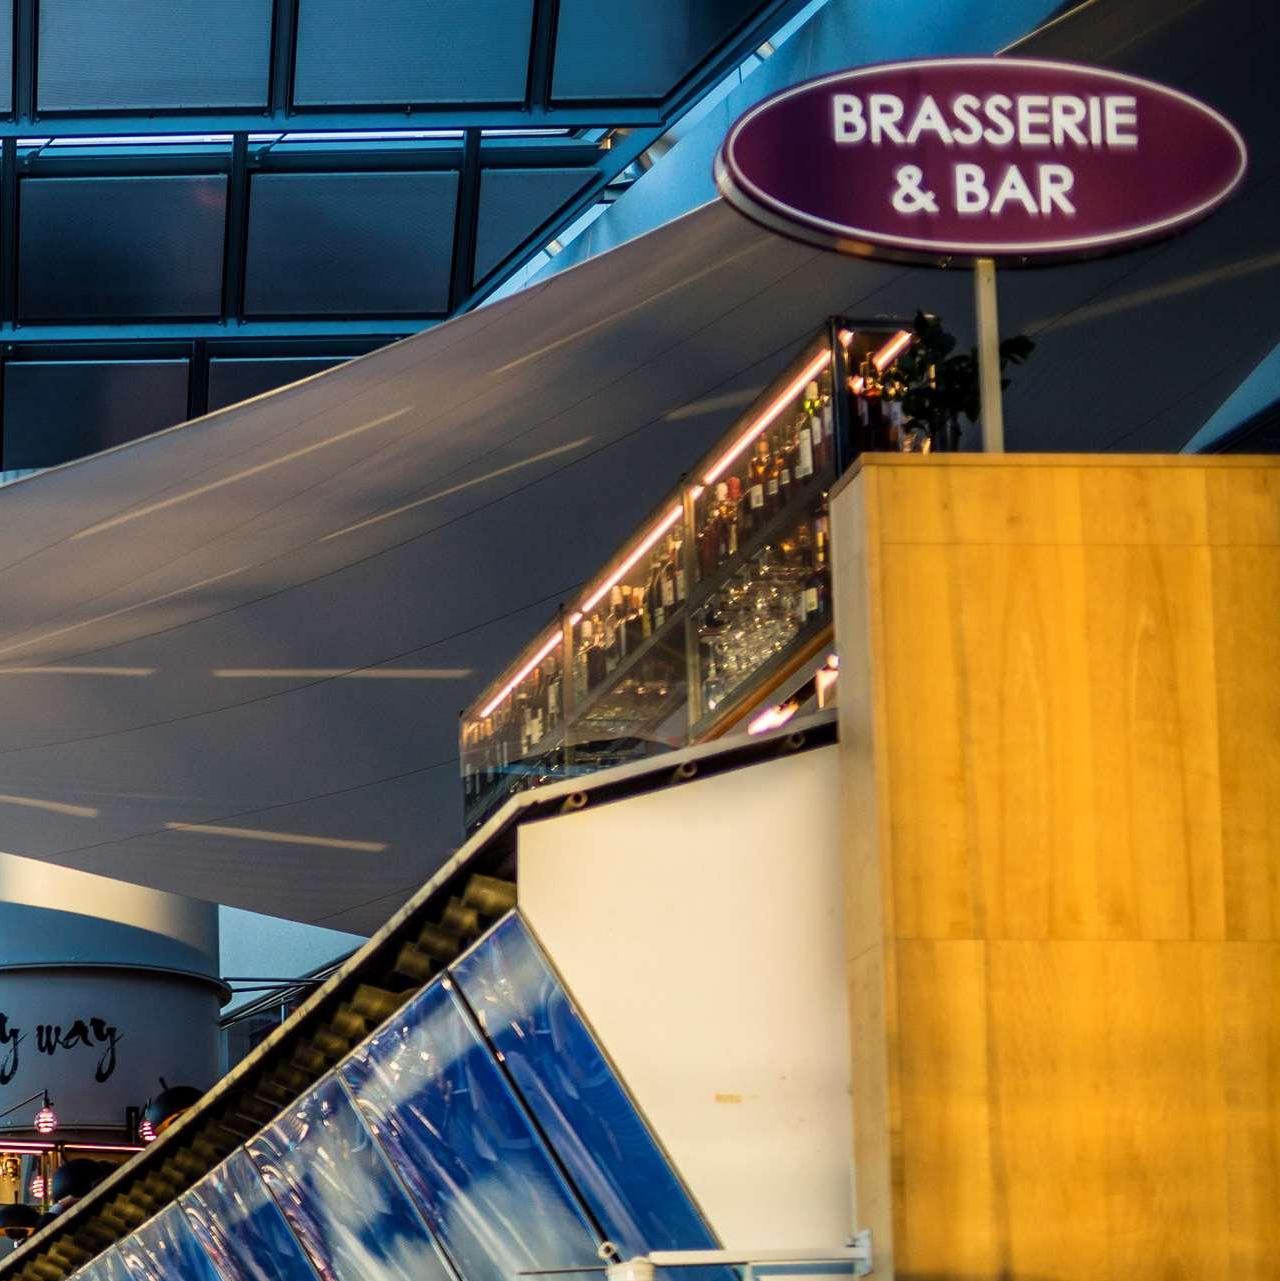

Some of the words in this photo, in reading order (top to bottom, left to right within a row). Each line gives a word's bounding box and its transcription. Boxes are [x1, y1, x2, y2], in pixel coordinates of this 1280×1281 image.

[832, 94, 1139, 147] BRASSERIE
[892, 165, 938, 215] &
[955, 165, 1076, 215] BAR
[36, 1017, 124, 1083] way
